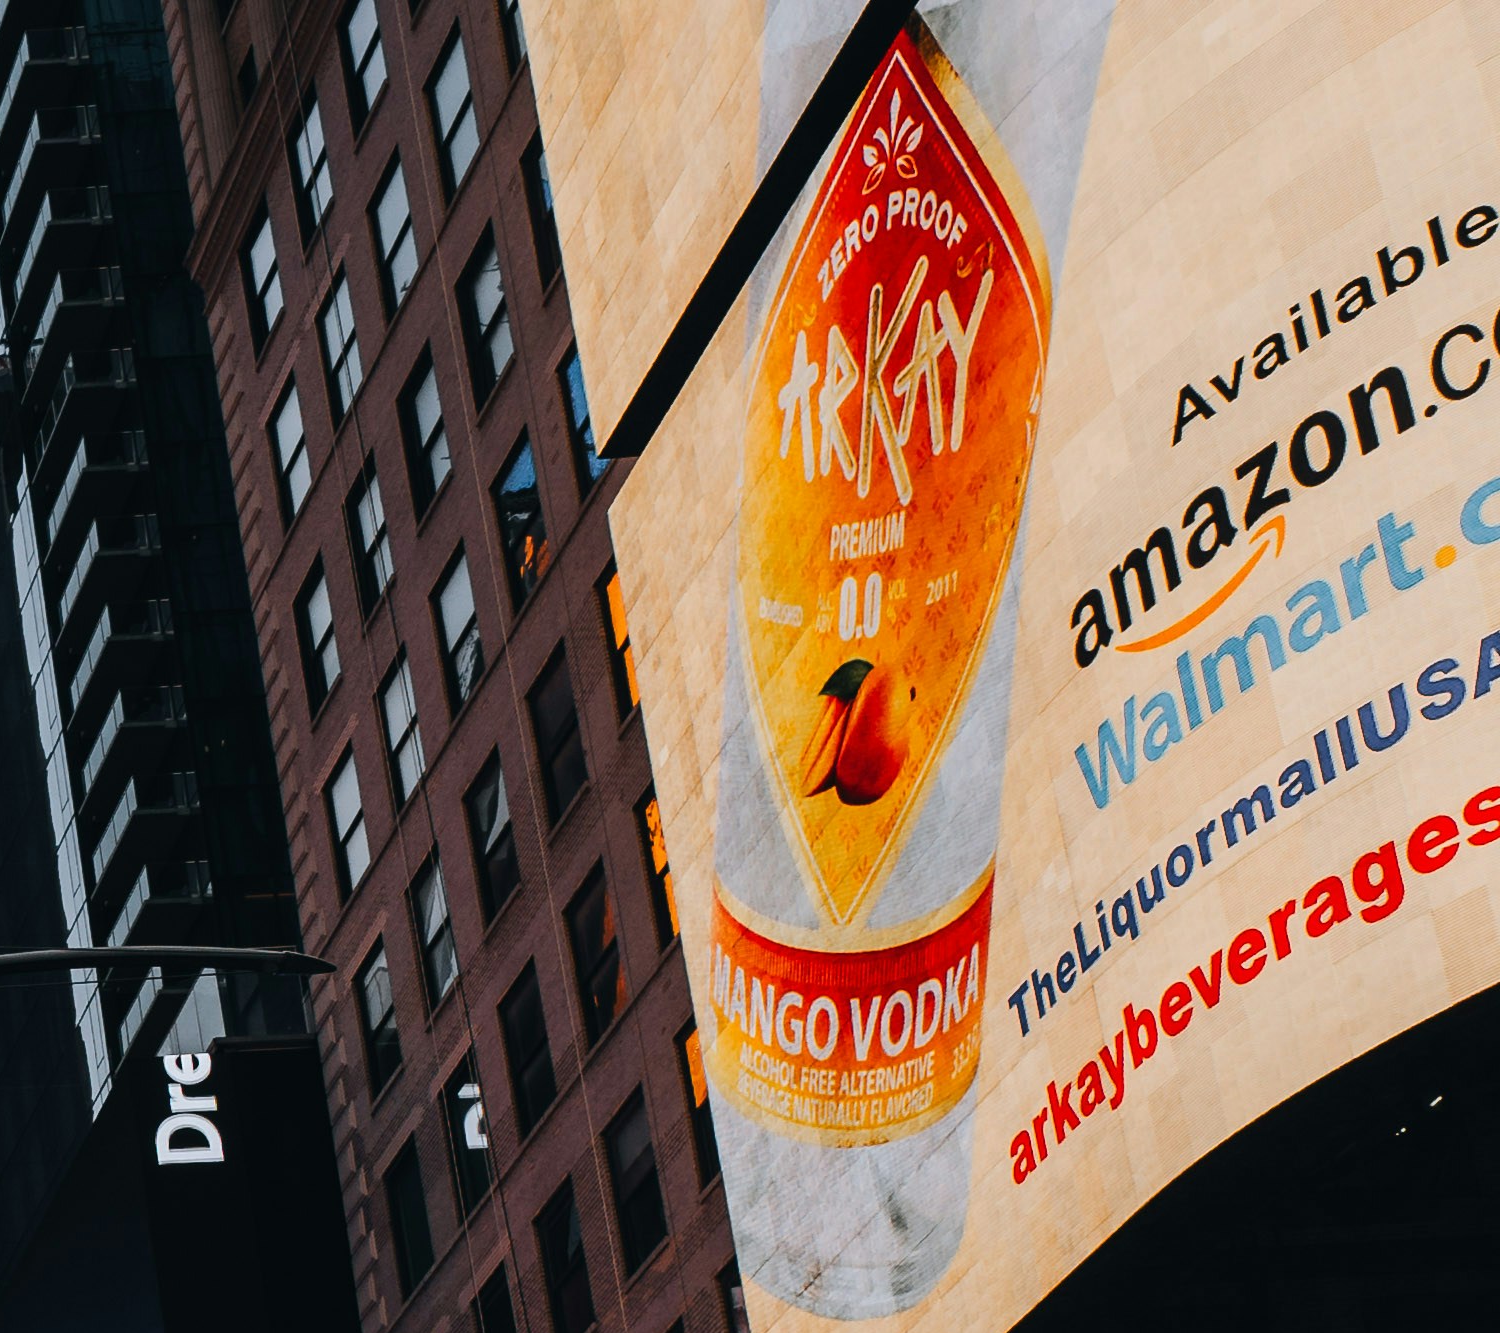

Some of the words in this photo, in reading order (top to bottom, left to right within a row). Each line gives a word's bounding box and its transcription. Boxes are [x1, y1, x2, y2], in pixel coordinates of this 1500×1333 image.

[816, 205, 877, 293] ZERO
[886, 187, 969, 252] PROOF
[779, 254, 994, 504] ARKAY
[830, 512, 905, 563] PREMIUM
[714, 943, 839, 1061] MANGO
[850, 941, 978, 1061] VODKA
[740, 1042, 797, 1089] ALCOHOL
[801, 1069, 836, 1096] FREE
[839, 1051, 935, 1096] ALTERNATIVE
[793, 1100, 868, 1125] NATURALLY
